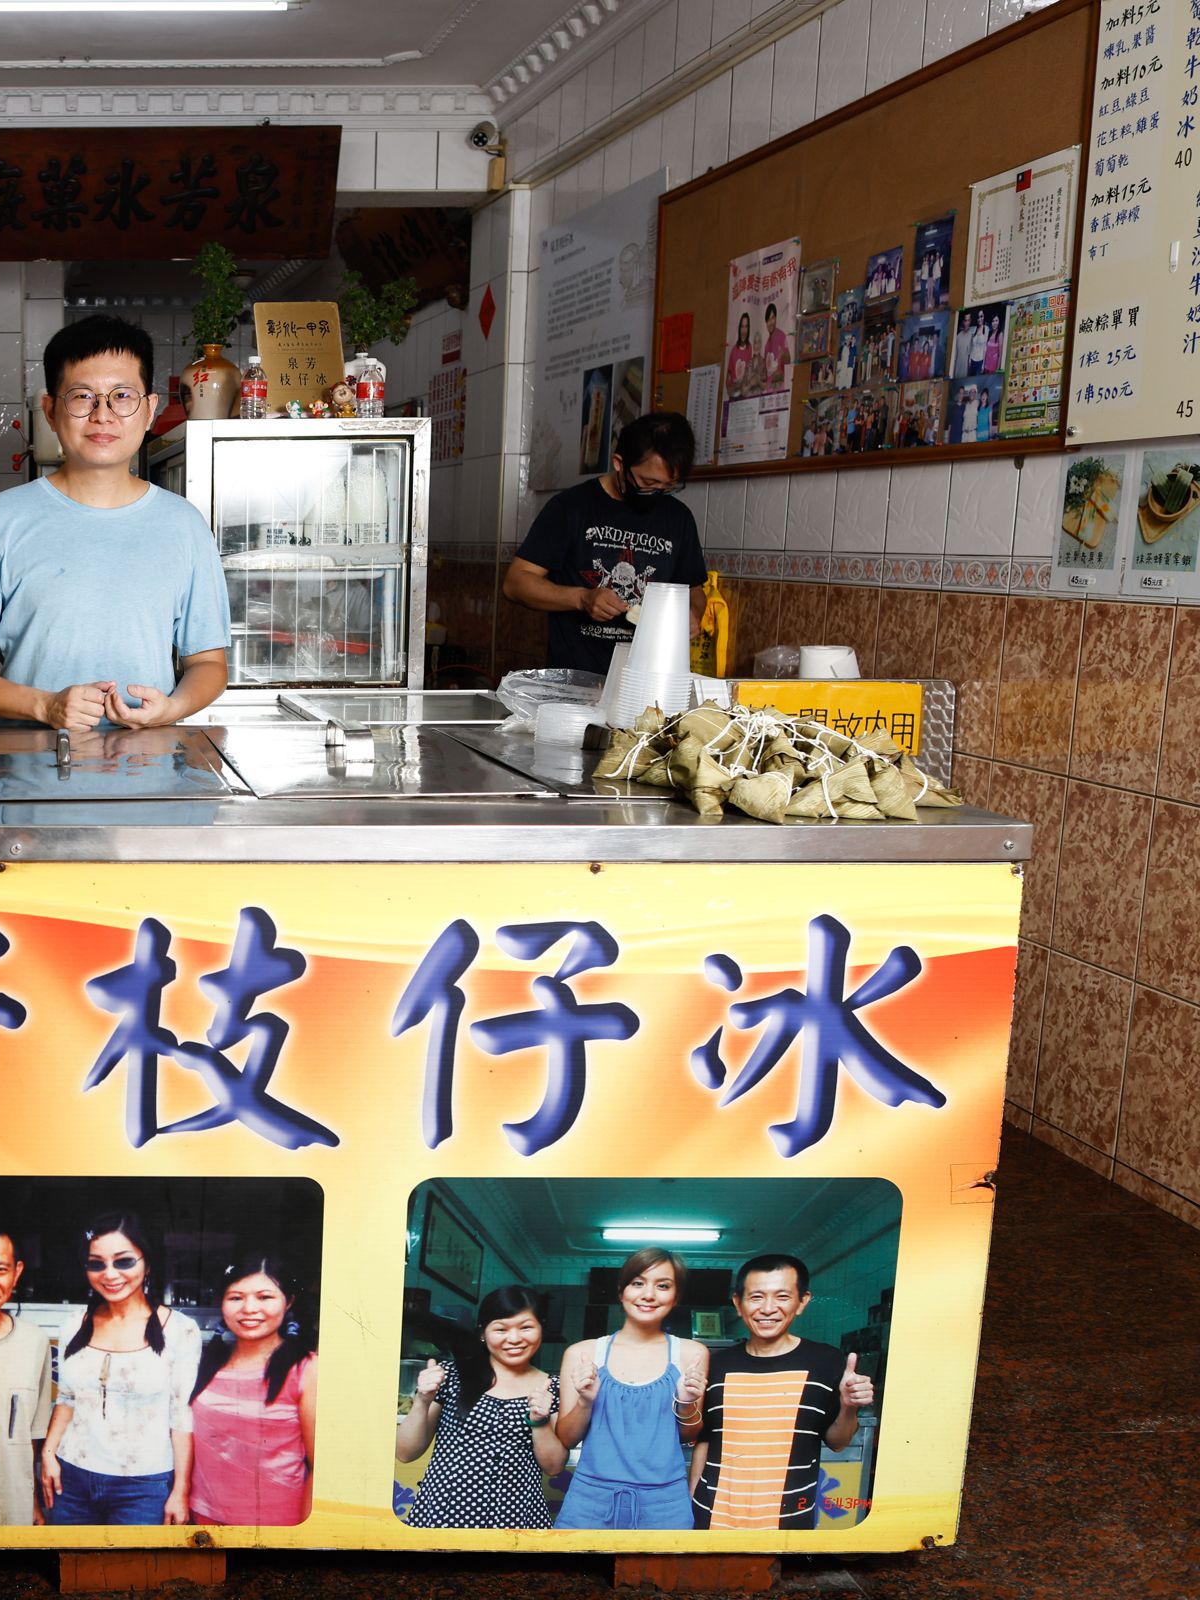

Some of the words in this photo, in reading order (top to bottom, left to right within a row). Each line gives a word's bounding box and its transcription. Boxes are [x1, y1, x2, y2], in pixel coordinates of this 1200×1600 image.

[1100, 56, 1163, 90] 加料10元
[1174, 148, 1192, 168] 40
[1090, 177, 1152, 207] 加料15元
[288, 357, 316, 370] 泉芳
[280, 373, 327, 388] 枝仔冰
[1176, 399, 1193, 418] 45
